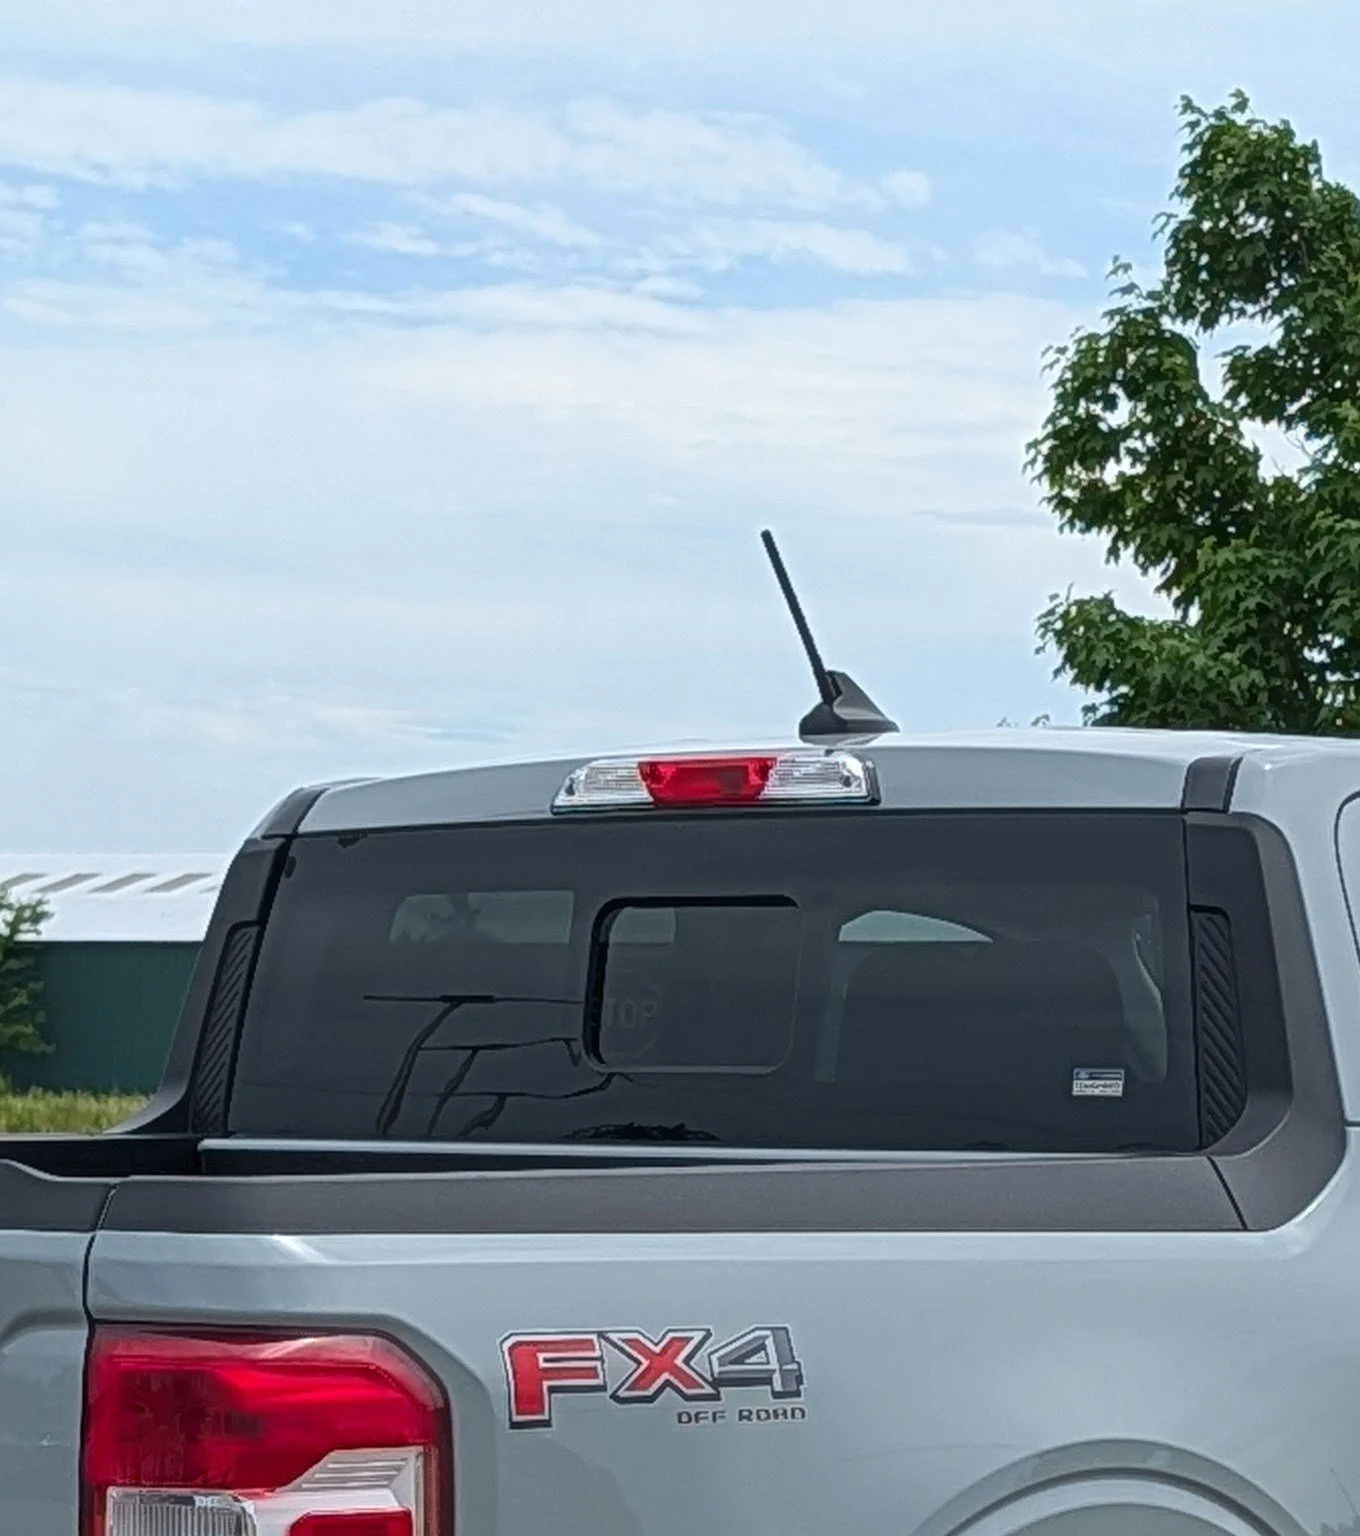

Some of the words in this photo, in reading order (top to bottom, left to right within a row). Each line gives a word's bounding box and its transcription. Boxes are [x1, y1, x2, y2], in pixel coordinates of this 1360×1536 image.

[500, 1324, 807, 1431] FX4
[677, 1408, 728, 1425] OFF
[738, 1406, 807, 1424] ROAD
